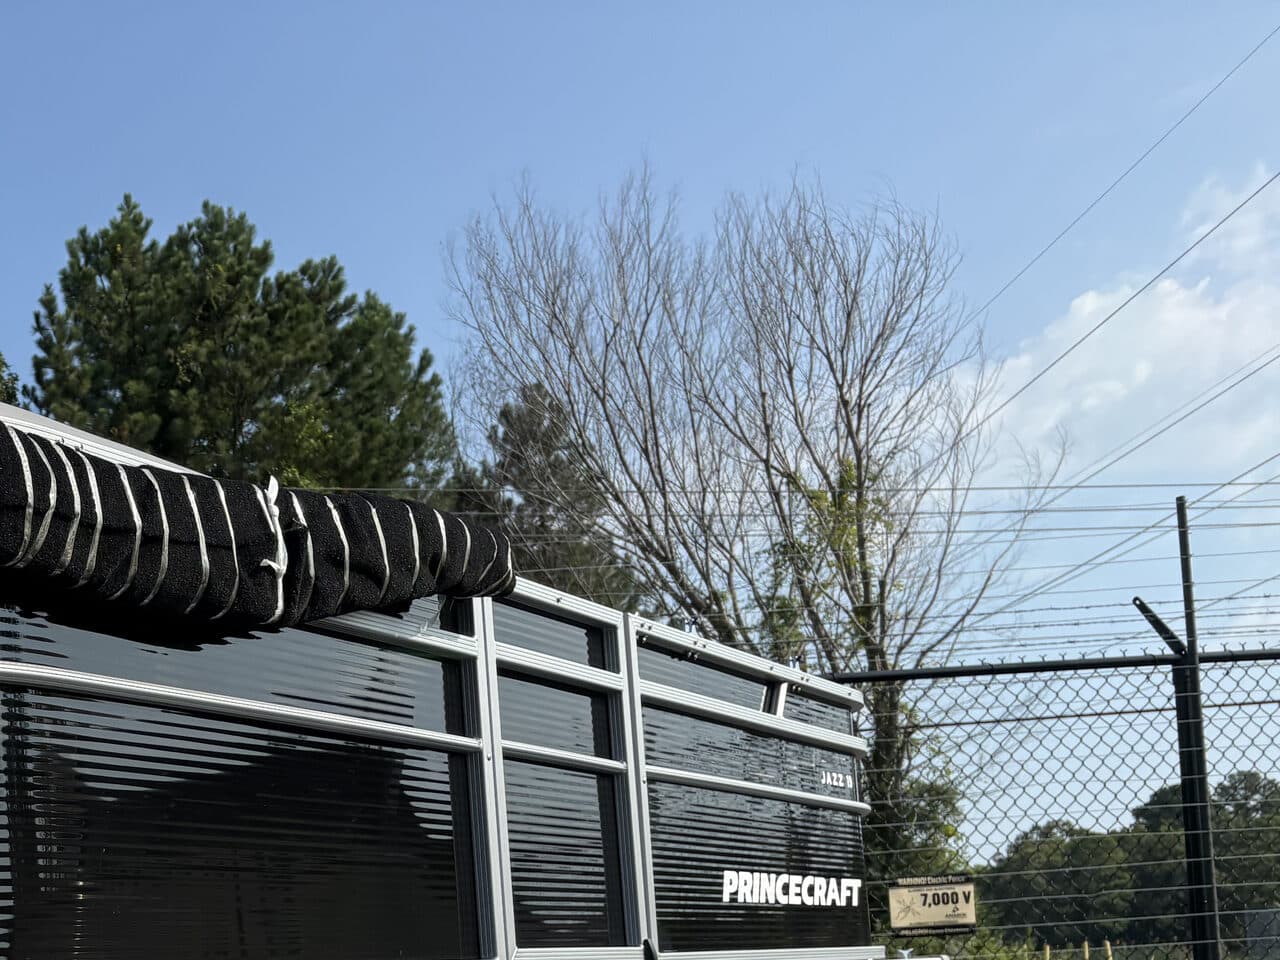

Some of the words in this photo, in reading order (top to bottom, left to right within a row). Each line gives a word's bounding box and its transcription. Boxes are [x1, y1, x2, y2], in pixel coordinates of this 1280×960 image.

[821, 771, 845, 787] JAZZ
[722, 870, 862, 907] PRINCECRAFT
[920, 891, 959, 908] 7,000
[962, 890, 972, 905] V
